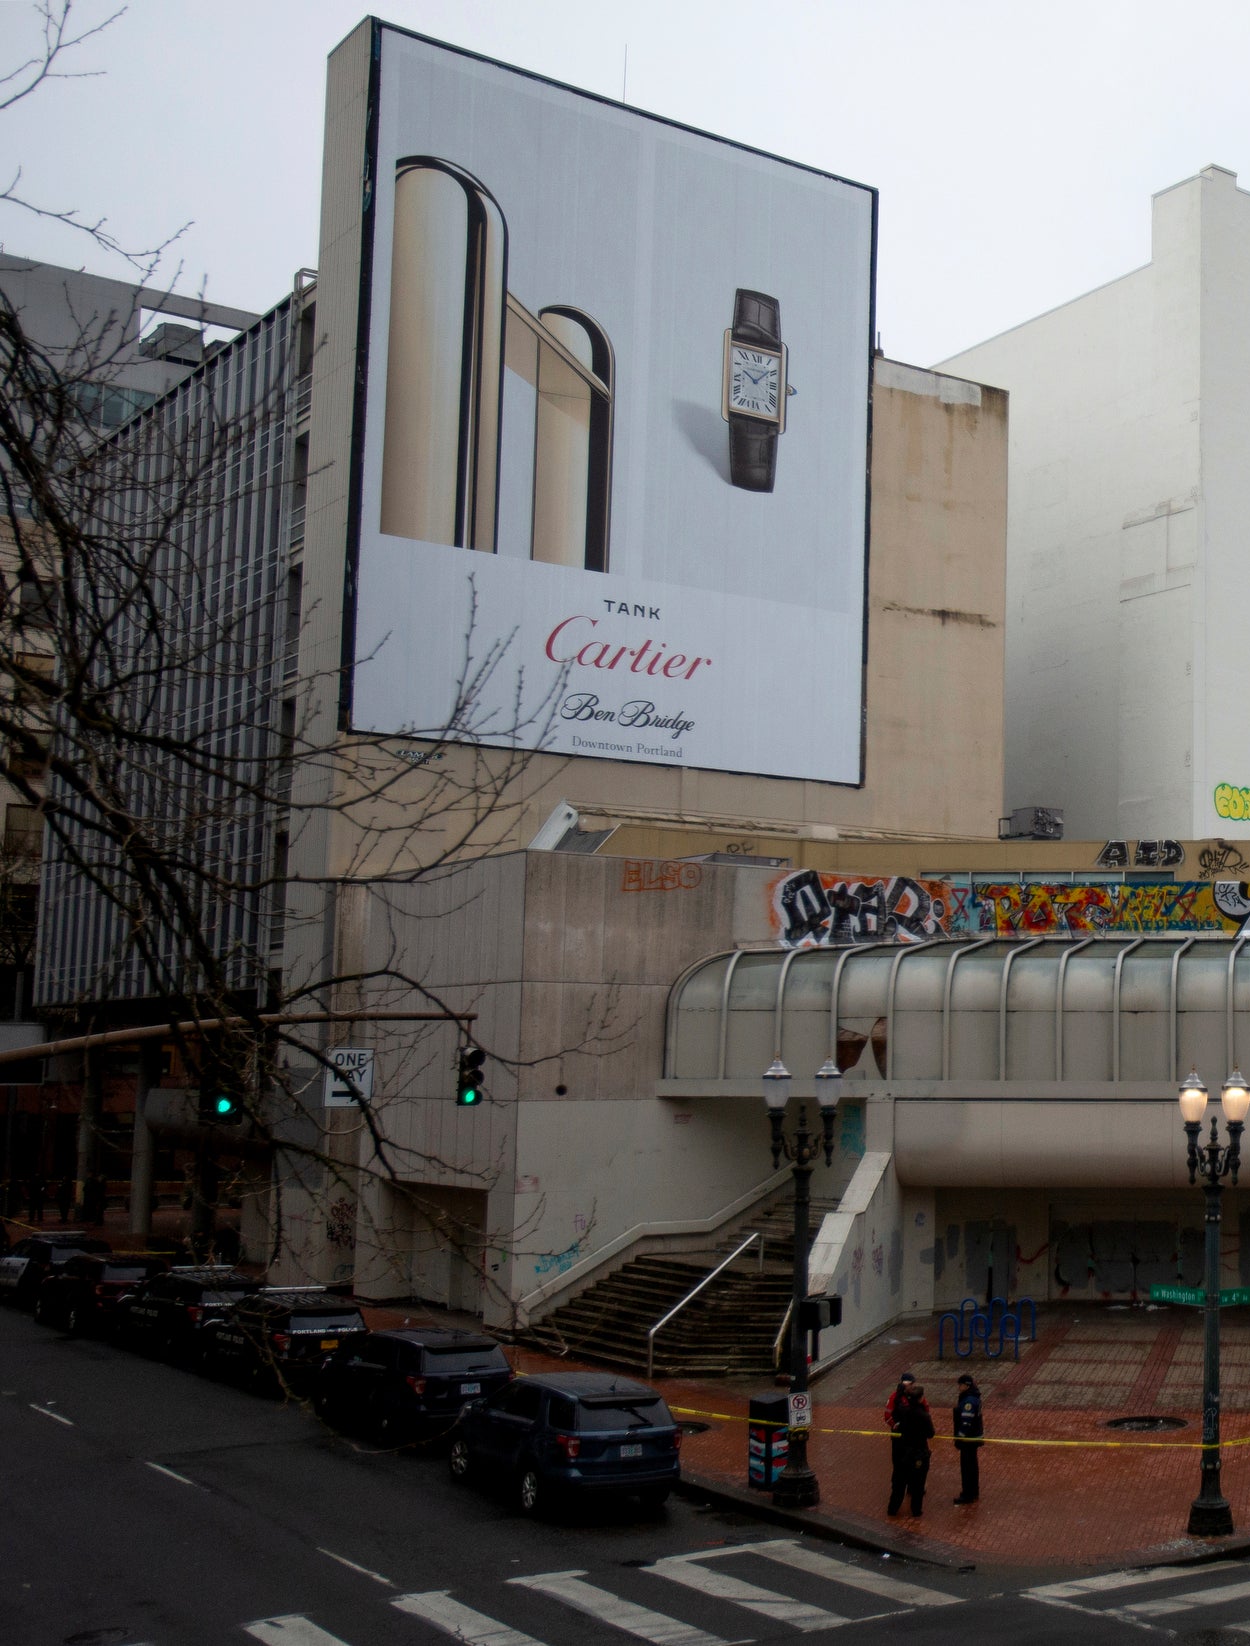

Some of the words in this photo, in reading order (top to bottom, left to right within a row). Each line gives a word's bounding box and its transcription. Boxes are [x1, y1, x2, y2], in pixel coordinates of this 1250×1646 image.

[604, 599, 661, 620] TANK
[545, 615, 712, 680] Cartier
[560, 693, 616, 723] Ben
[617, 700, 696, 740] Bridge
[572, 735, 633, 754] Downtown
[636, 743, 683, 758] Portland
[621, 860, 702, 892] ELSO
[336, 1053, 366, 1066] ONE
[1161, 1289, 1196, 1303] Washington
